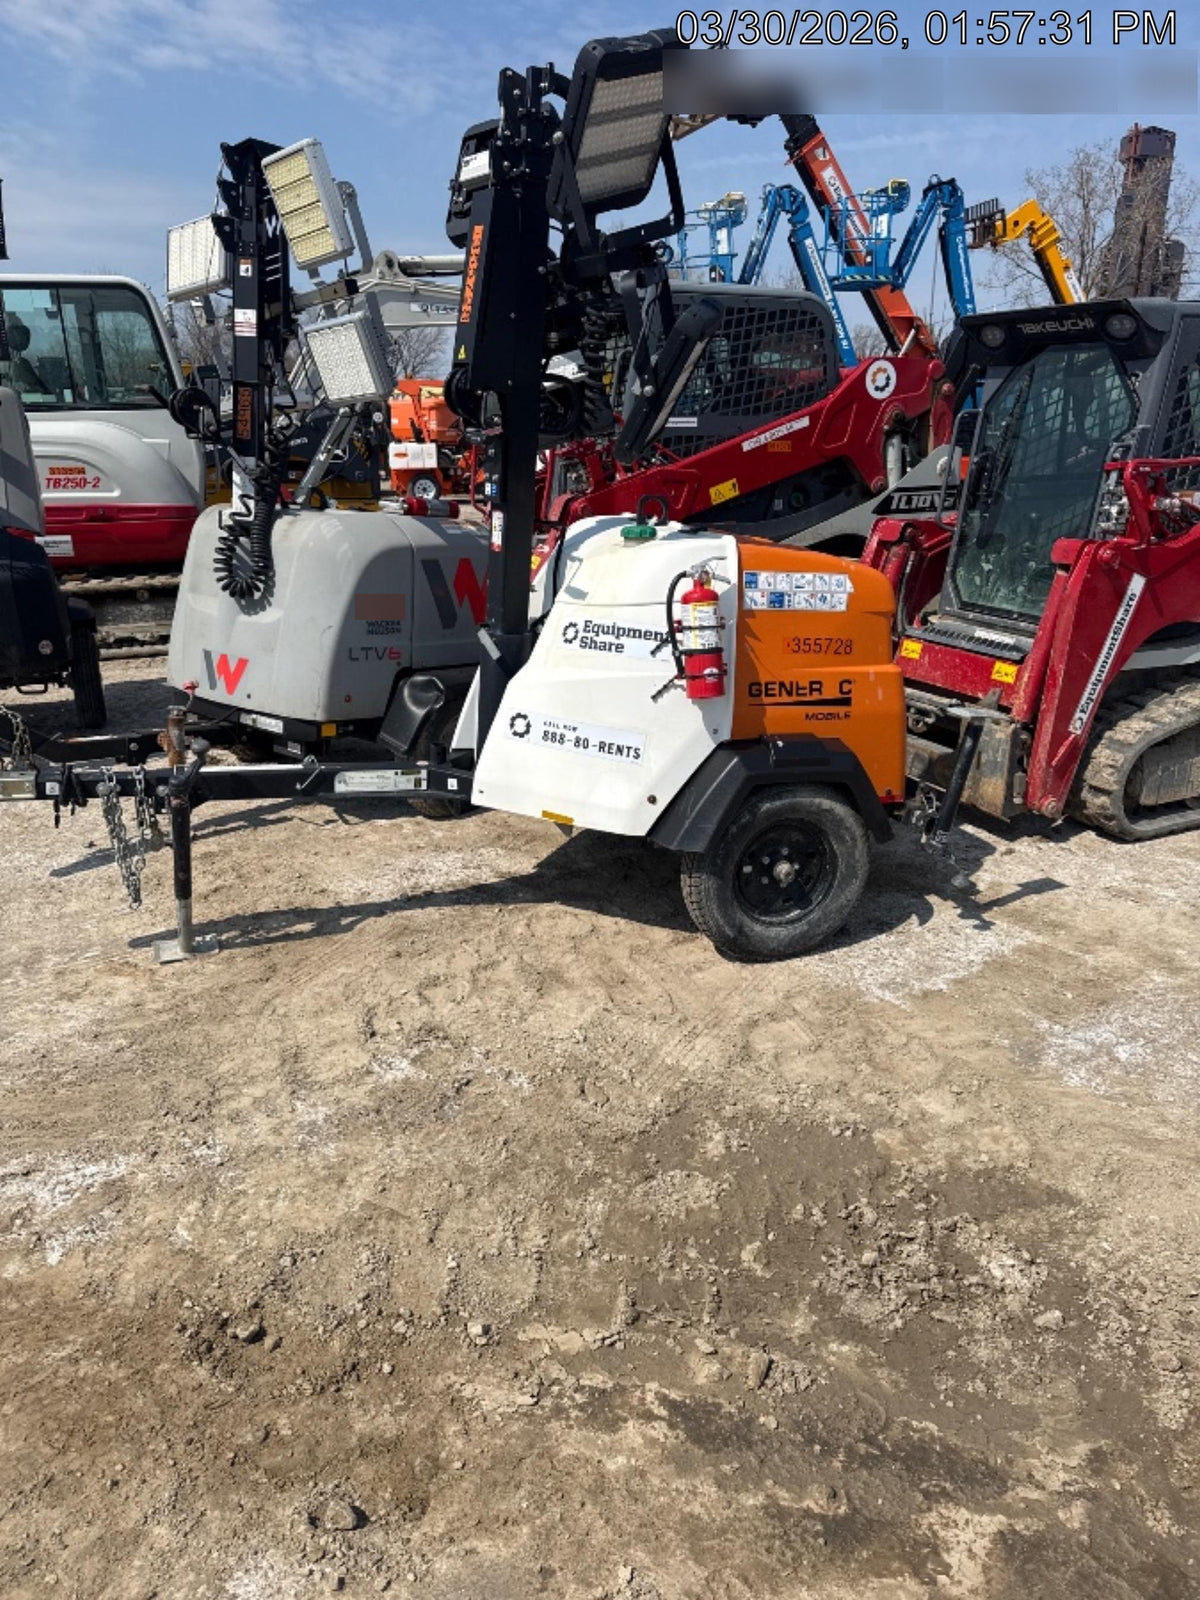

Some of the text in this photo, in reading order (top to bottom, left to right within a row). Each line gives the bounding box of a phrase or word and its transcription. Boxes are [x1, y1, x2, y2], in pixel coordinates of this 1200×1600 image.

[1016, 317, 1096, 334] TAKEUCHI
[45, 476, 101, 490] TB250-2
[579, 636, 625, 654] Share
[791, 636, 853, 656] 355728
[349, 646, 402, 662] LTV6
[1079, 592, 1137, 716] EquipmentShare
[804, 711, 852, 721] MOBILE
[541, 729, 642, 760] 888-80-RENTS
